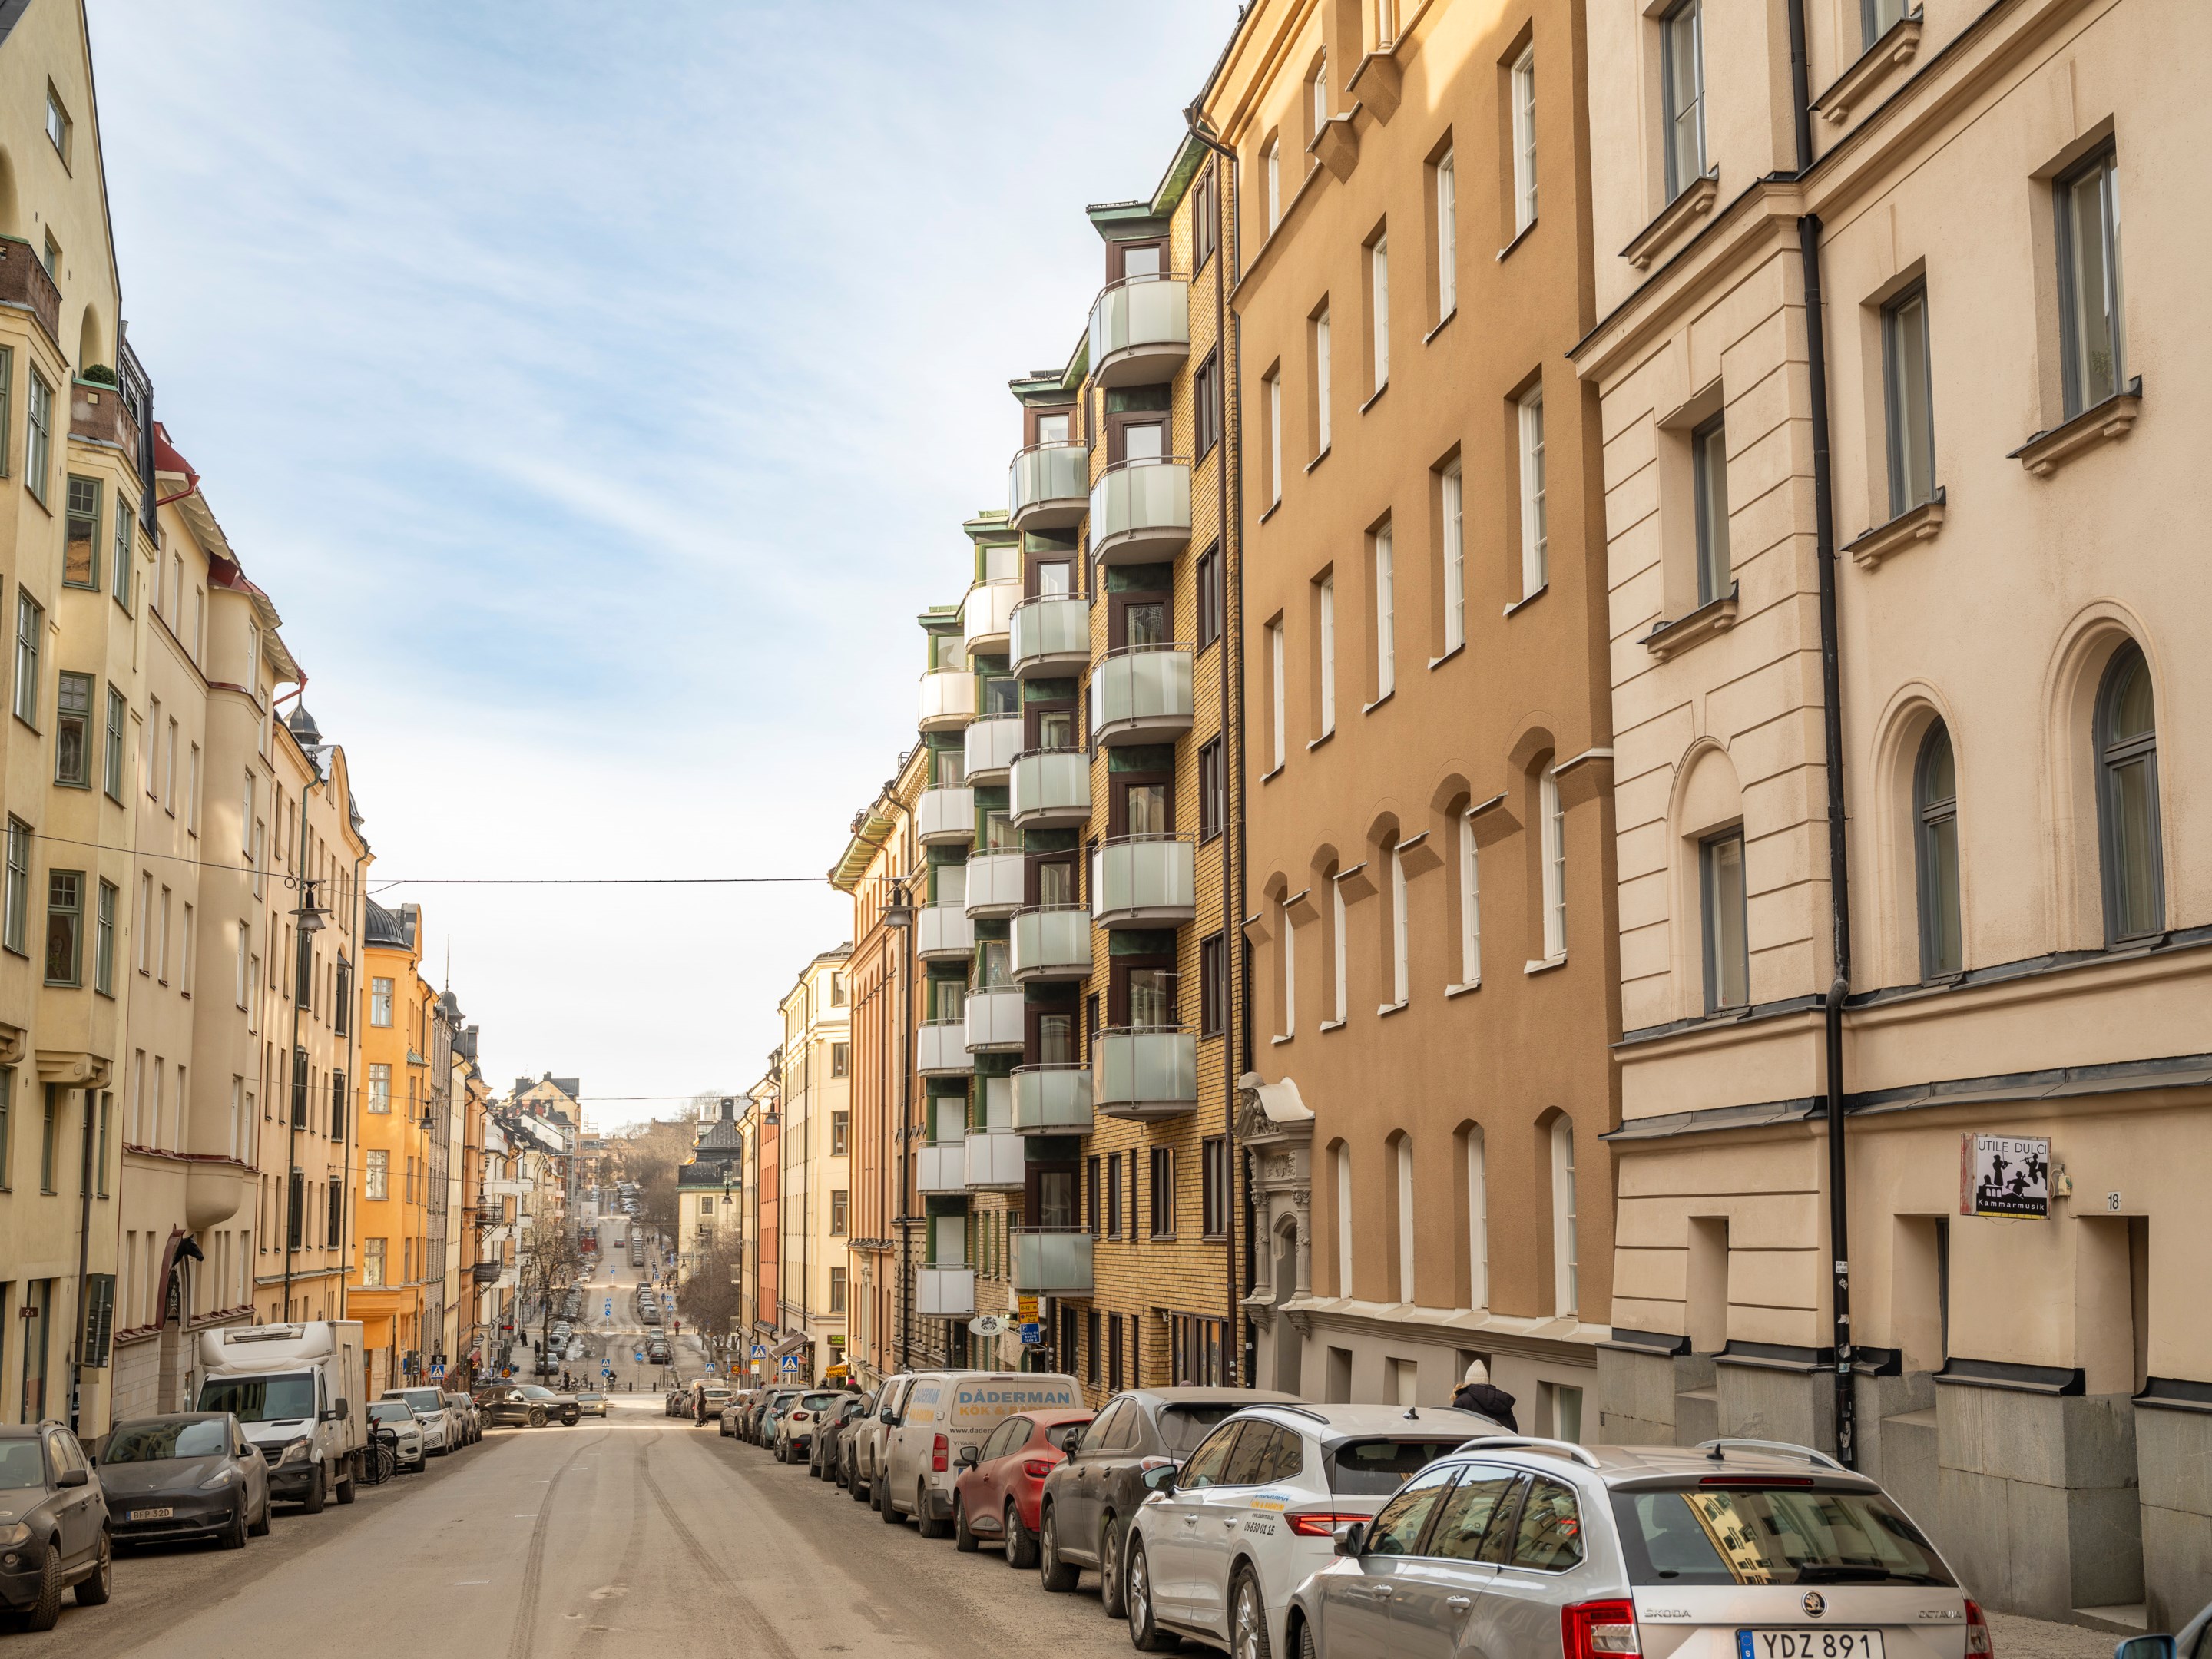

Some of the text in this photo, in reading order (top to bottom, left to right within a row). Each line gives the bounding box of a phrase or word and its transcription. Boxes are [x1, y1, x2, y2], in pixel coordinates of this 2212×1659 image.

[1978, 1140, 2047, 1155] UTILE DULCI
[1978, 1198, 2045, 1211] Kammarmusik
[2108, 1193, 2120, 1210] 18
[959, 1389, 1070, 1404] DÅDERMAN
[959, 1405, 989, 1416] KÖK
[994, 1406, 1005, 1416] &
[134, 1508, 170, 1519] BFP 32D
[1260, 1524, 1267, 1534] 01
[1267, 1525, 1275, 1535] 15
[1644, 1608, 1692, 1618] ŠKODA
[1918, 1610, 1963, 1620] OCTAVIA
[1762, 1634, 1871, 1659] YDZ 891
